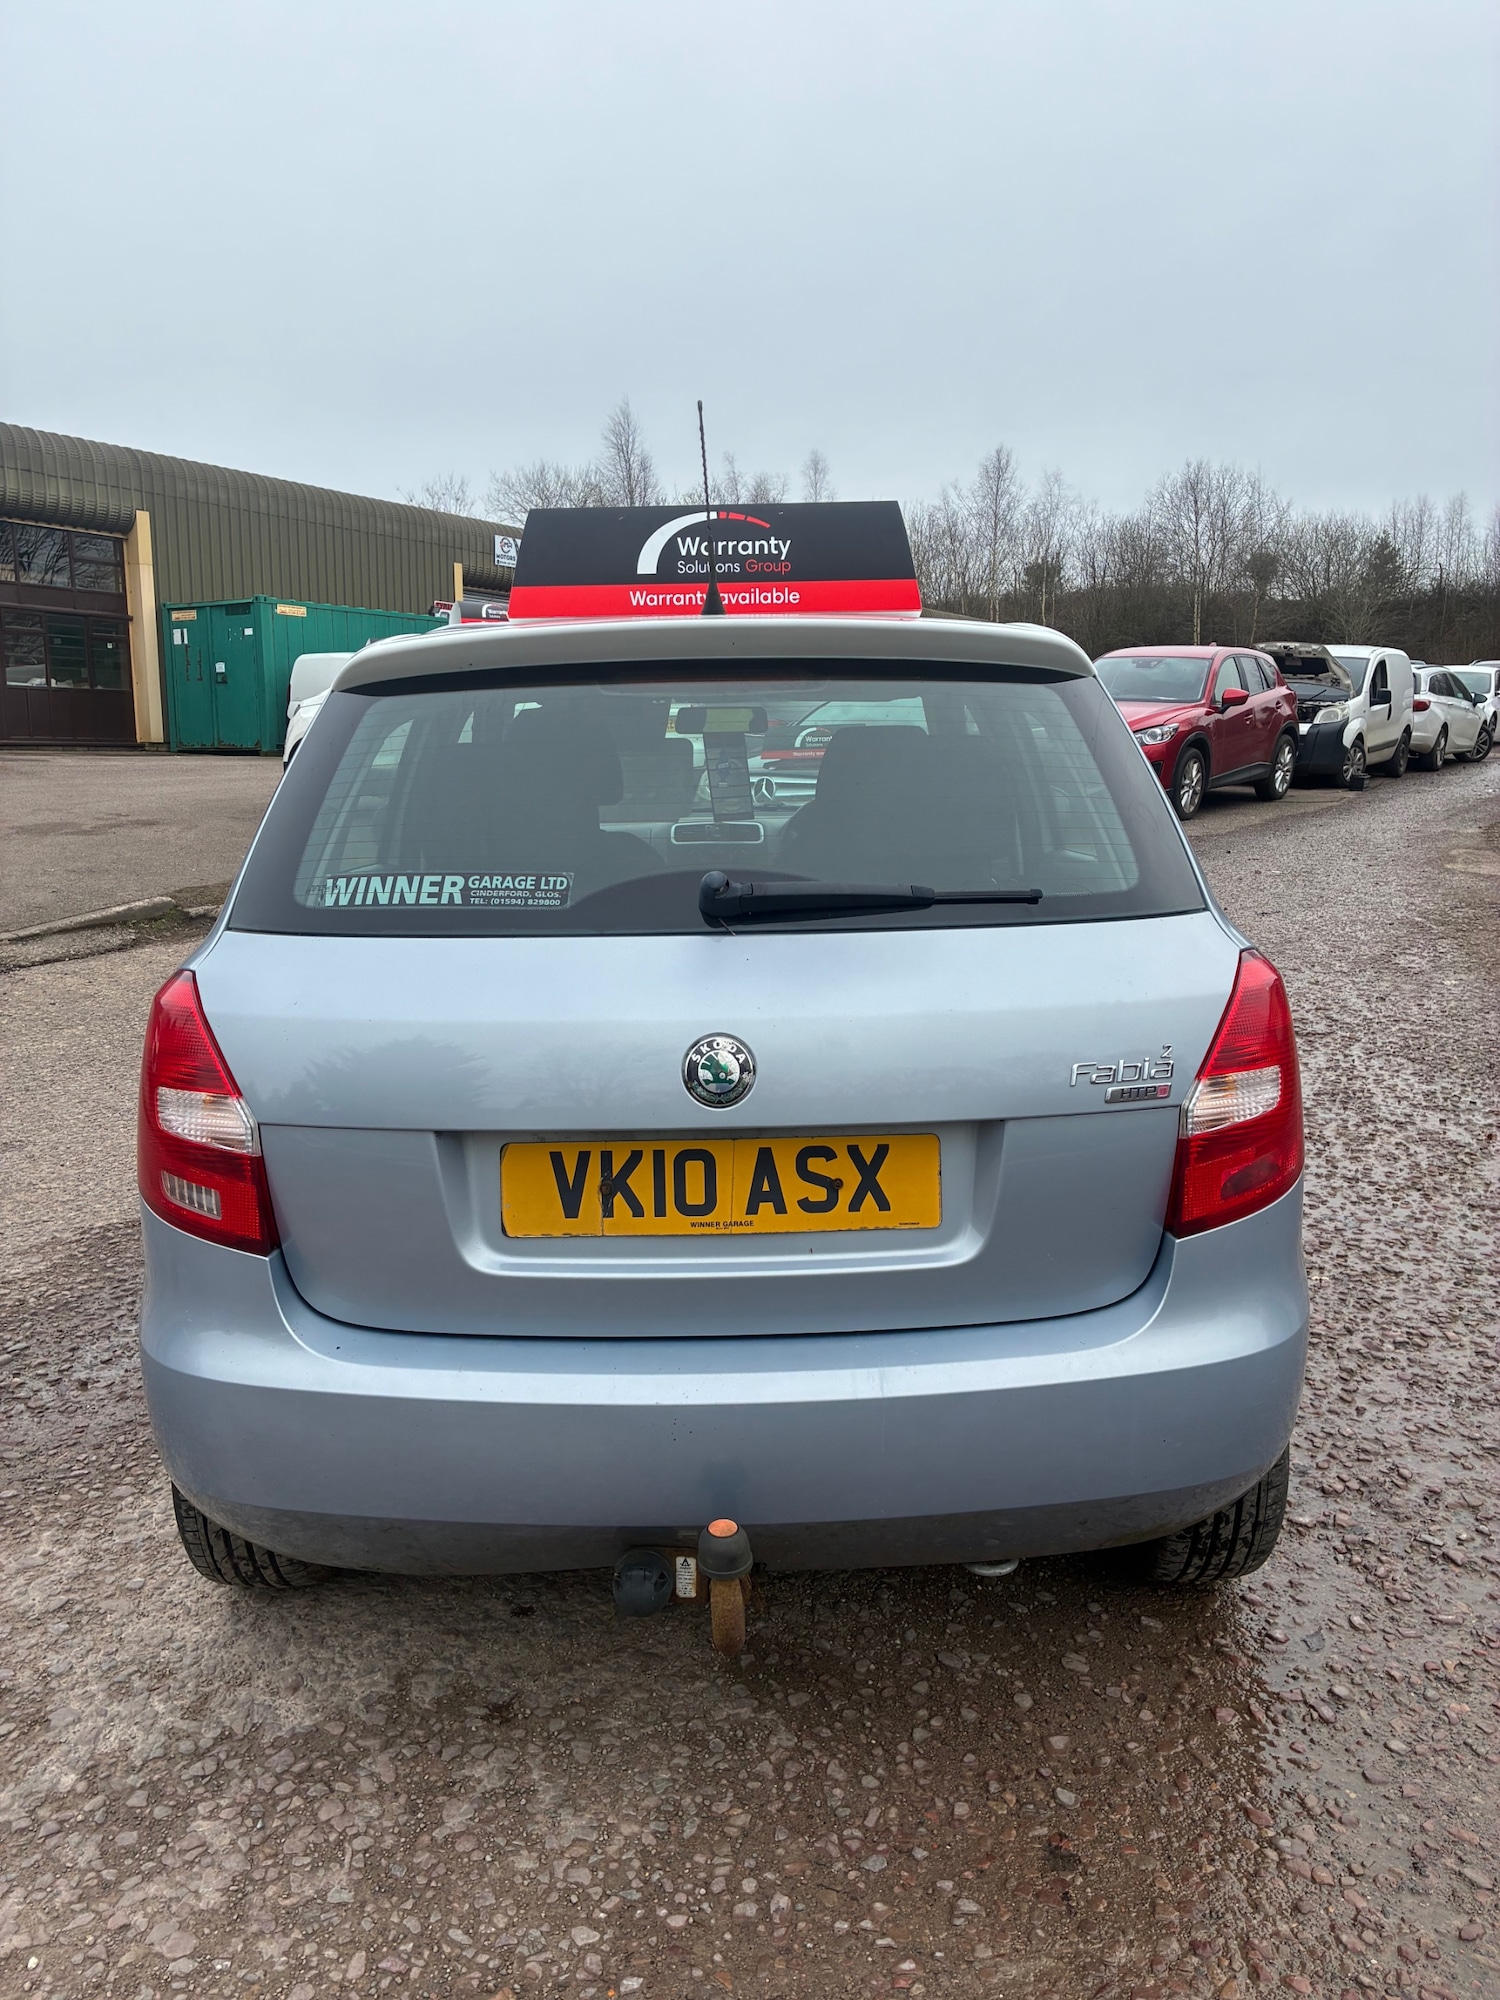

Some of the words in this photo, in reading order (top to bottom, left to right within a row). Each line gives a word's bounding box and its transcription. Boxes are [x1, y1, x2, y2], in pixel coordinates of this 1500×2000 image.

[677, 560, 740, 573] Solutons
[745, 559, 791, 575] Group
[720, 587, 800, 604] available
[325, 875, 465, 906] WINNER
[468, 875, 537, 889] GARAGE
[540, 876, 568, 890] LTD
[470, 889, 532, 898] CINDERFORD,
[535, 890, 562, 898] GLOS.
[490, 898, 525, 906] (01594)
[1069, 1057, 1175, 1087] Fabia
[1120, 1086, 1157, 1099] HTP
[549, 1149, 717, 1219] VK10
[745, 1144, 891, 1215] ASX
